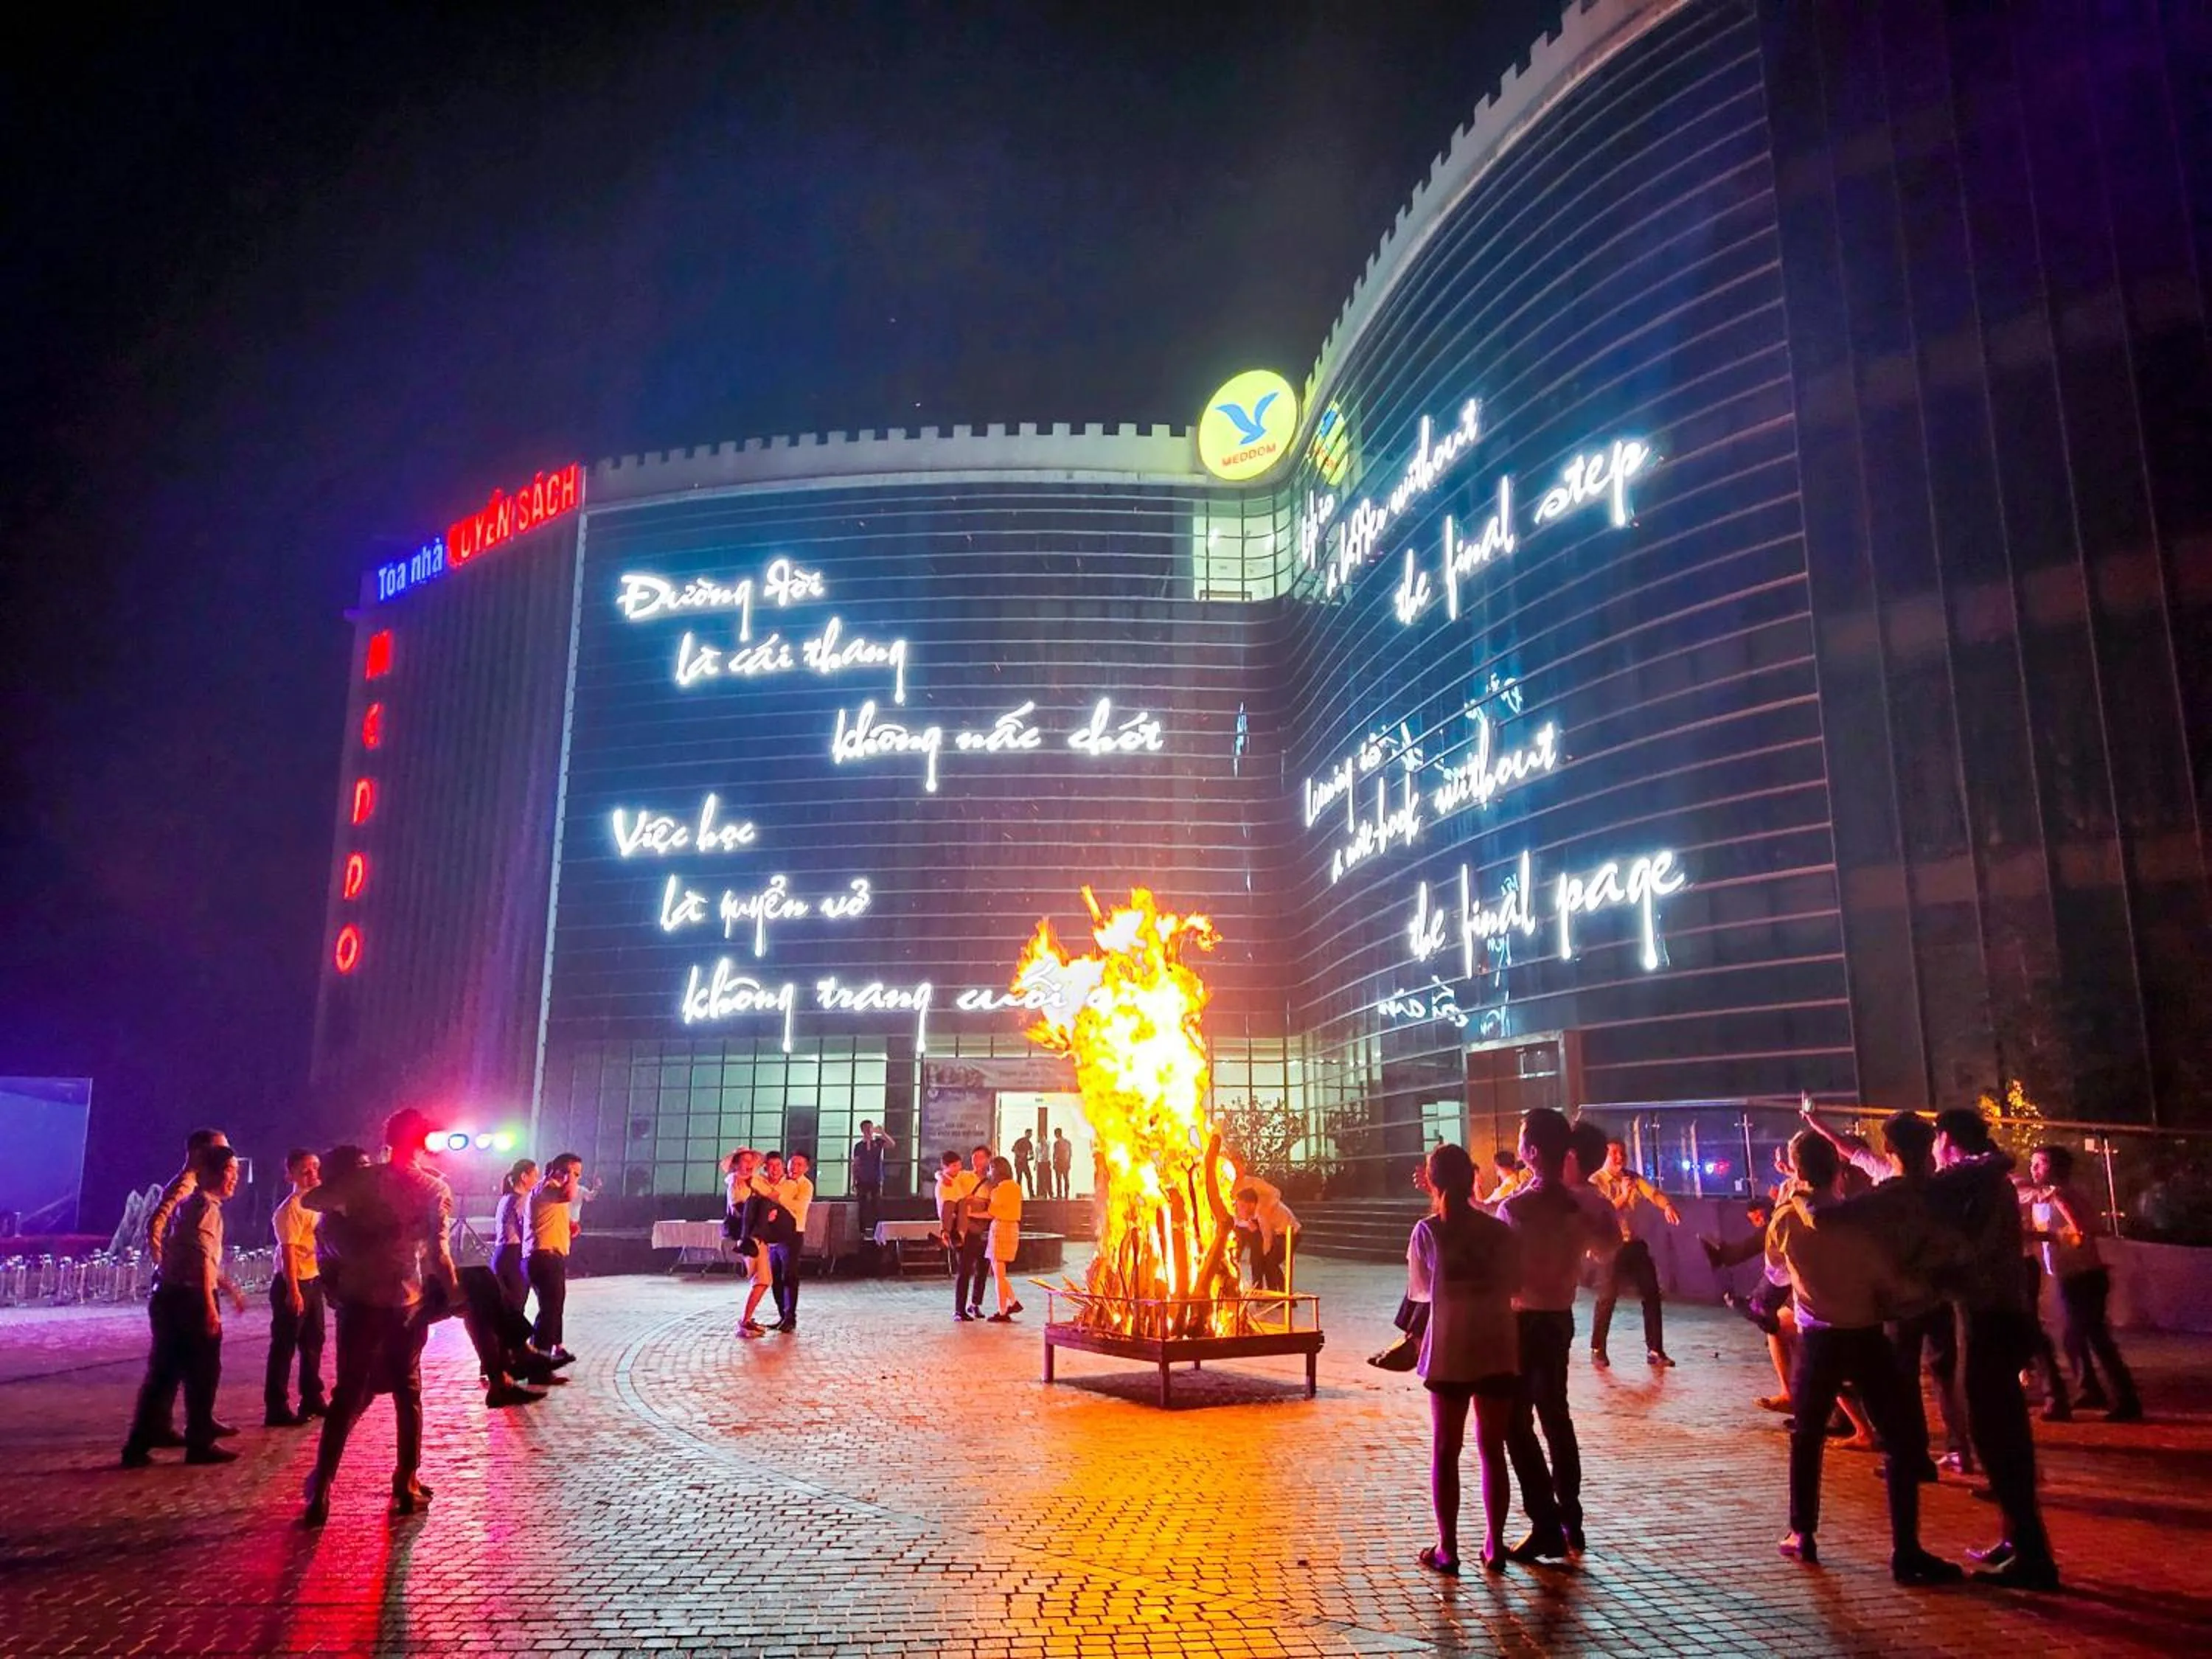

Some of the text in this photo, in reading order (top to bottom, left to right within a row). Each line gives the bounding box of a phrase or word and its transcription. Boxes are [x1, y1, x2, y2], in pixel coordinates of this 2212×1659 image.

[518, 463, 577, 532] SÁCH
[1221, 444, 1277, 467] MEDDOM
[1390, 398, 1481, 515] without
[1444, 476, 1515, 621] final
[1534, 439, 1650, 528] step
[618, 559, 825, 642] Đường đời
[676, 616, 907, 704] là cái thang
[832, 700, 942, 793] không
[955, 701, 1043, 752] nấc
[1433, 717, 1557, 810] without
[613, 793, 756, 858] Việc học
[660, 875, 708, 932] là
[820, 879, 872, 919] vở
[1410, 882, 1446, 961] the
[1463, 850, 1536, 979] final
[1556, 851, 1685, 970] page
[683, 957, 795, 1053] không
[816, 977, 933, 1054] trang
